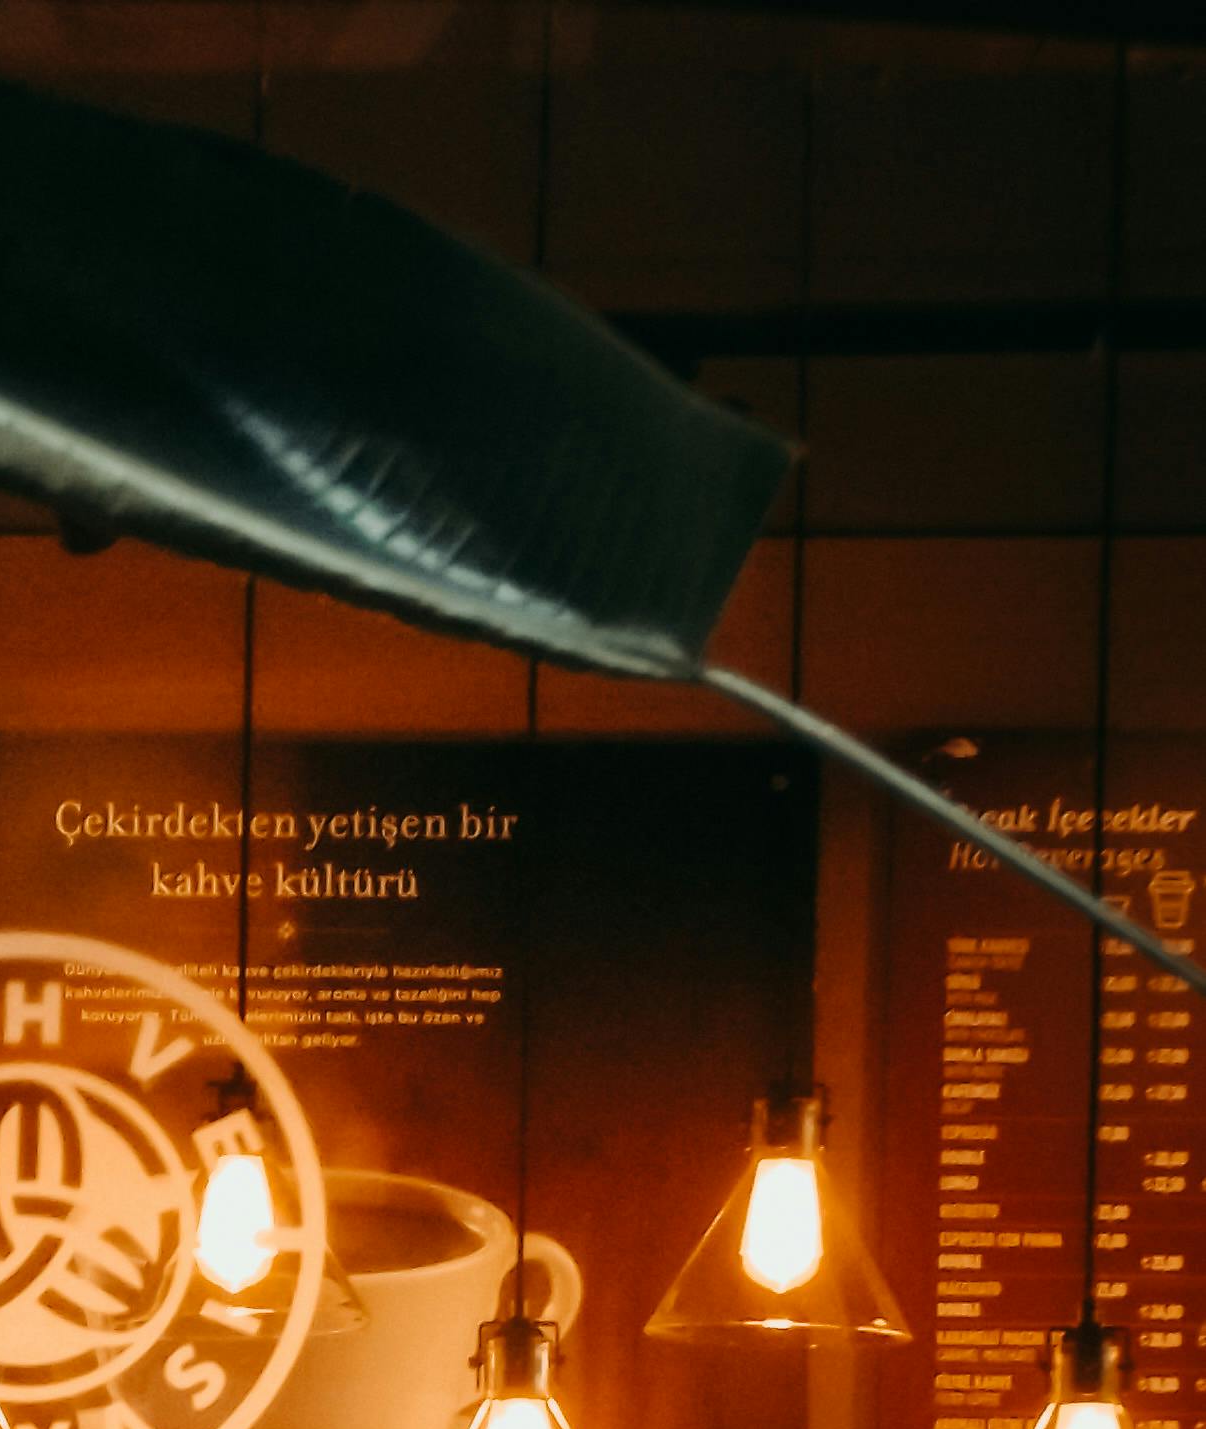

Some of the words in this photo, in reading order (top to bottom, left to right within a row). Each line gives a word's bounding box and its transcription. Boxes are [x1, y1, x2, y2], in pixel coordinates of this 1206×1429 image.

[54, 800, 296, 847] Çekirdekten
[304, 805, 448, 851] yetişen
[459, 804, 519, 841] bir
[151, 861, 263, 898] kahve
[274, 862, 420, 898] kültürü
